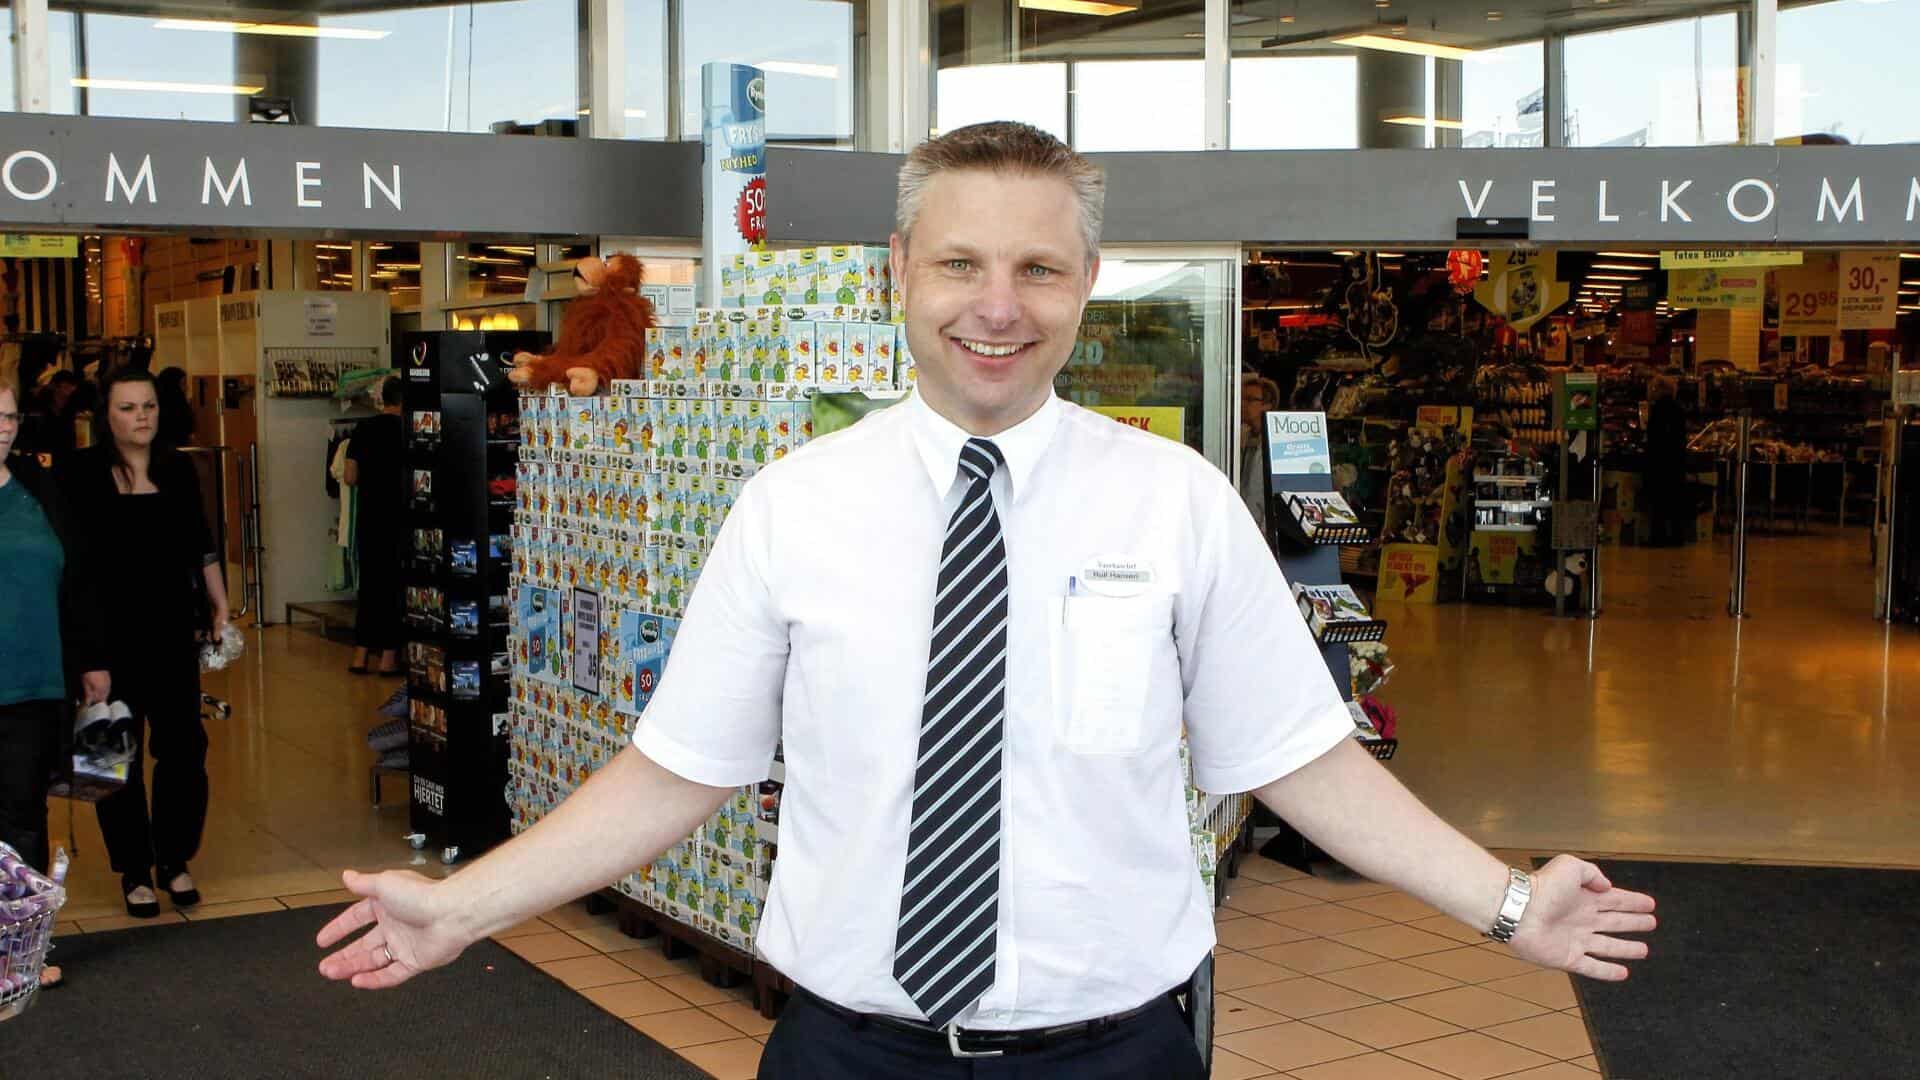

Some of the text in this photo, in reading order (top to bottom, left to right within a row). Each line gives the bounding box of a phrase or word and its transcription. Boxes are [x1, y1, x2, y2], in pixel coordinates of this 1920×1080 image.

[2, 150, 402, 211] OMMEN
[1848, 266, 1889, 295] 30,-
[1273, 415, 1320, 434] Mood
[414, 783, 445, 810] HJERTET
